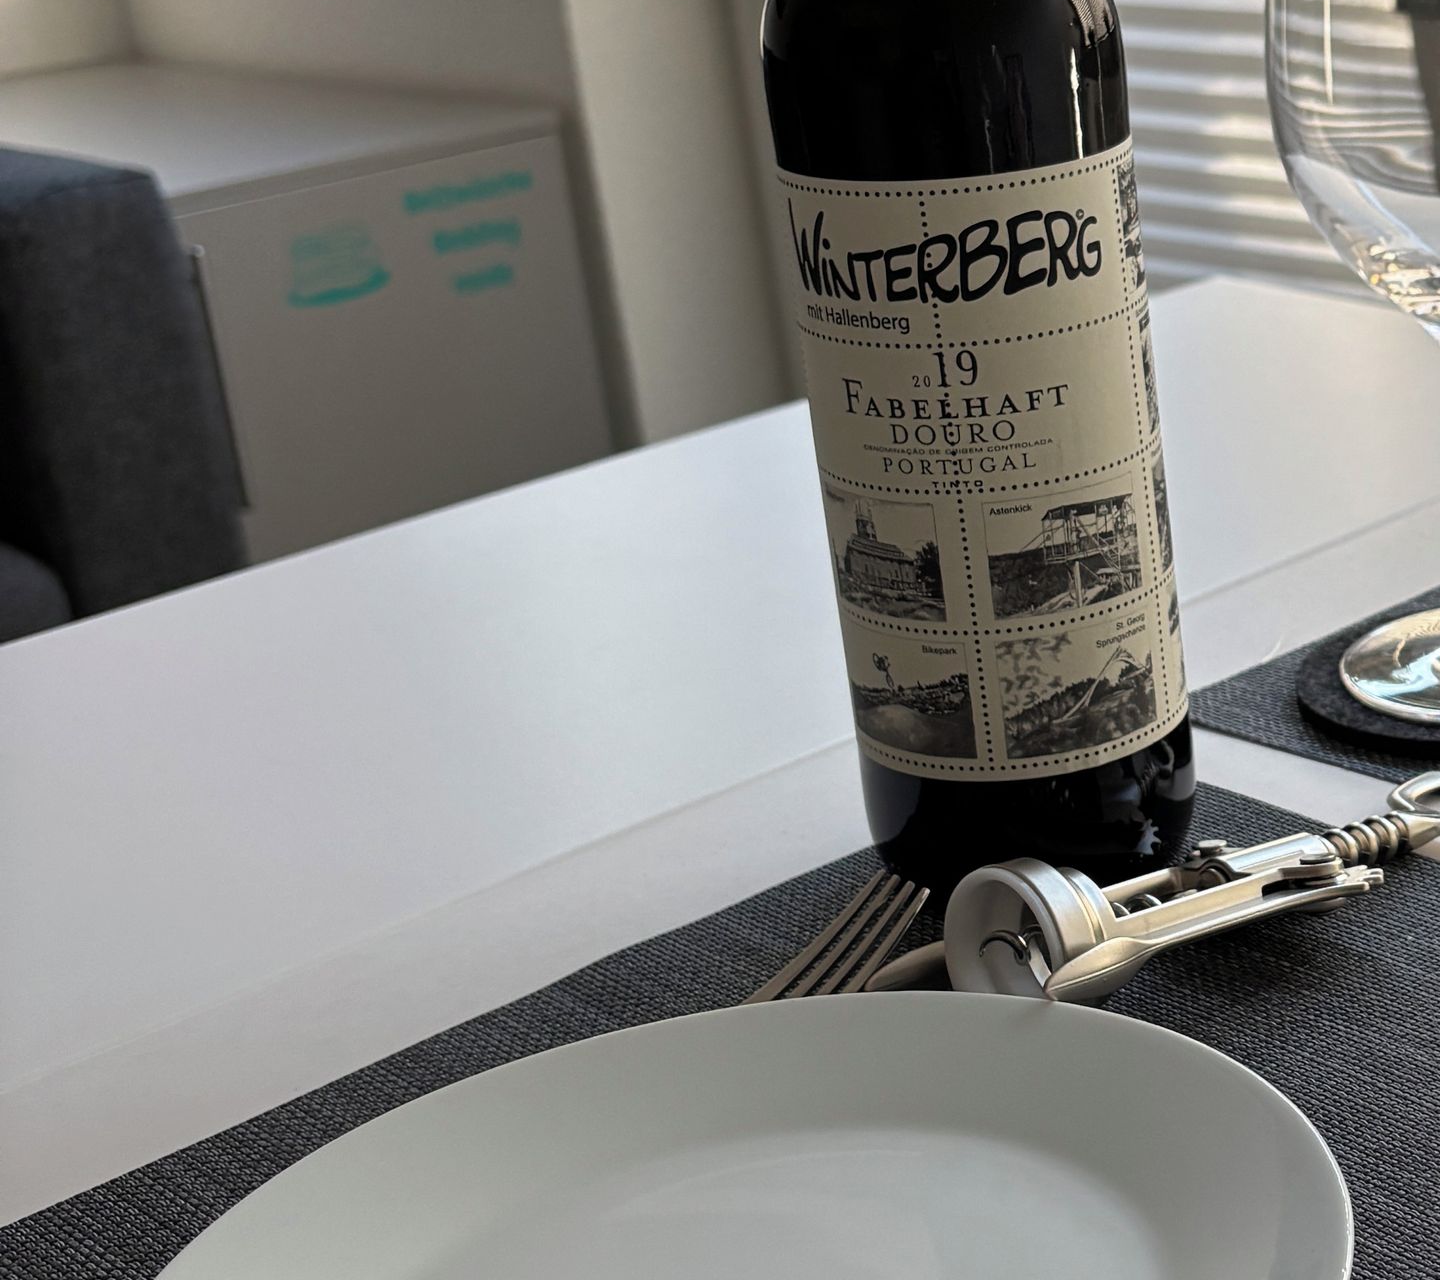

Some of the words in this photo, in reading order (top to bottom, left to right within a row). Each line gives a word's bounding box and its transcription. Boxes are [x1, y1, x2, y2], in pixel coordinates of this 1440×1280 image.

[807, 303, 824, 321] mit
[826, 305, 911, 334] Hallenberg
[841, 377, 1069, 421] FABELHAFT
[889, 420, 1016, 446] DOURO
[986, 437, 1054, 453] CONTROLADA
[883, 453, 1037, 475] PORTUGAL
[932, 478, 985, 488] TINTO
[921, 644, 958, 656] Bikepark
